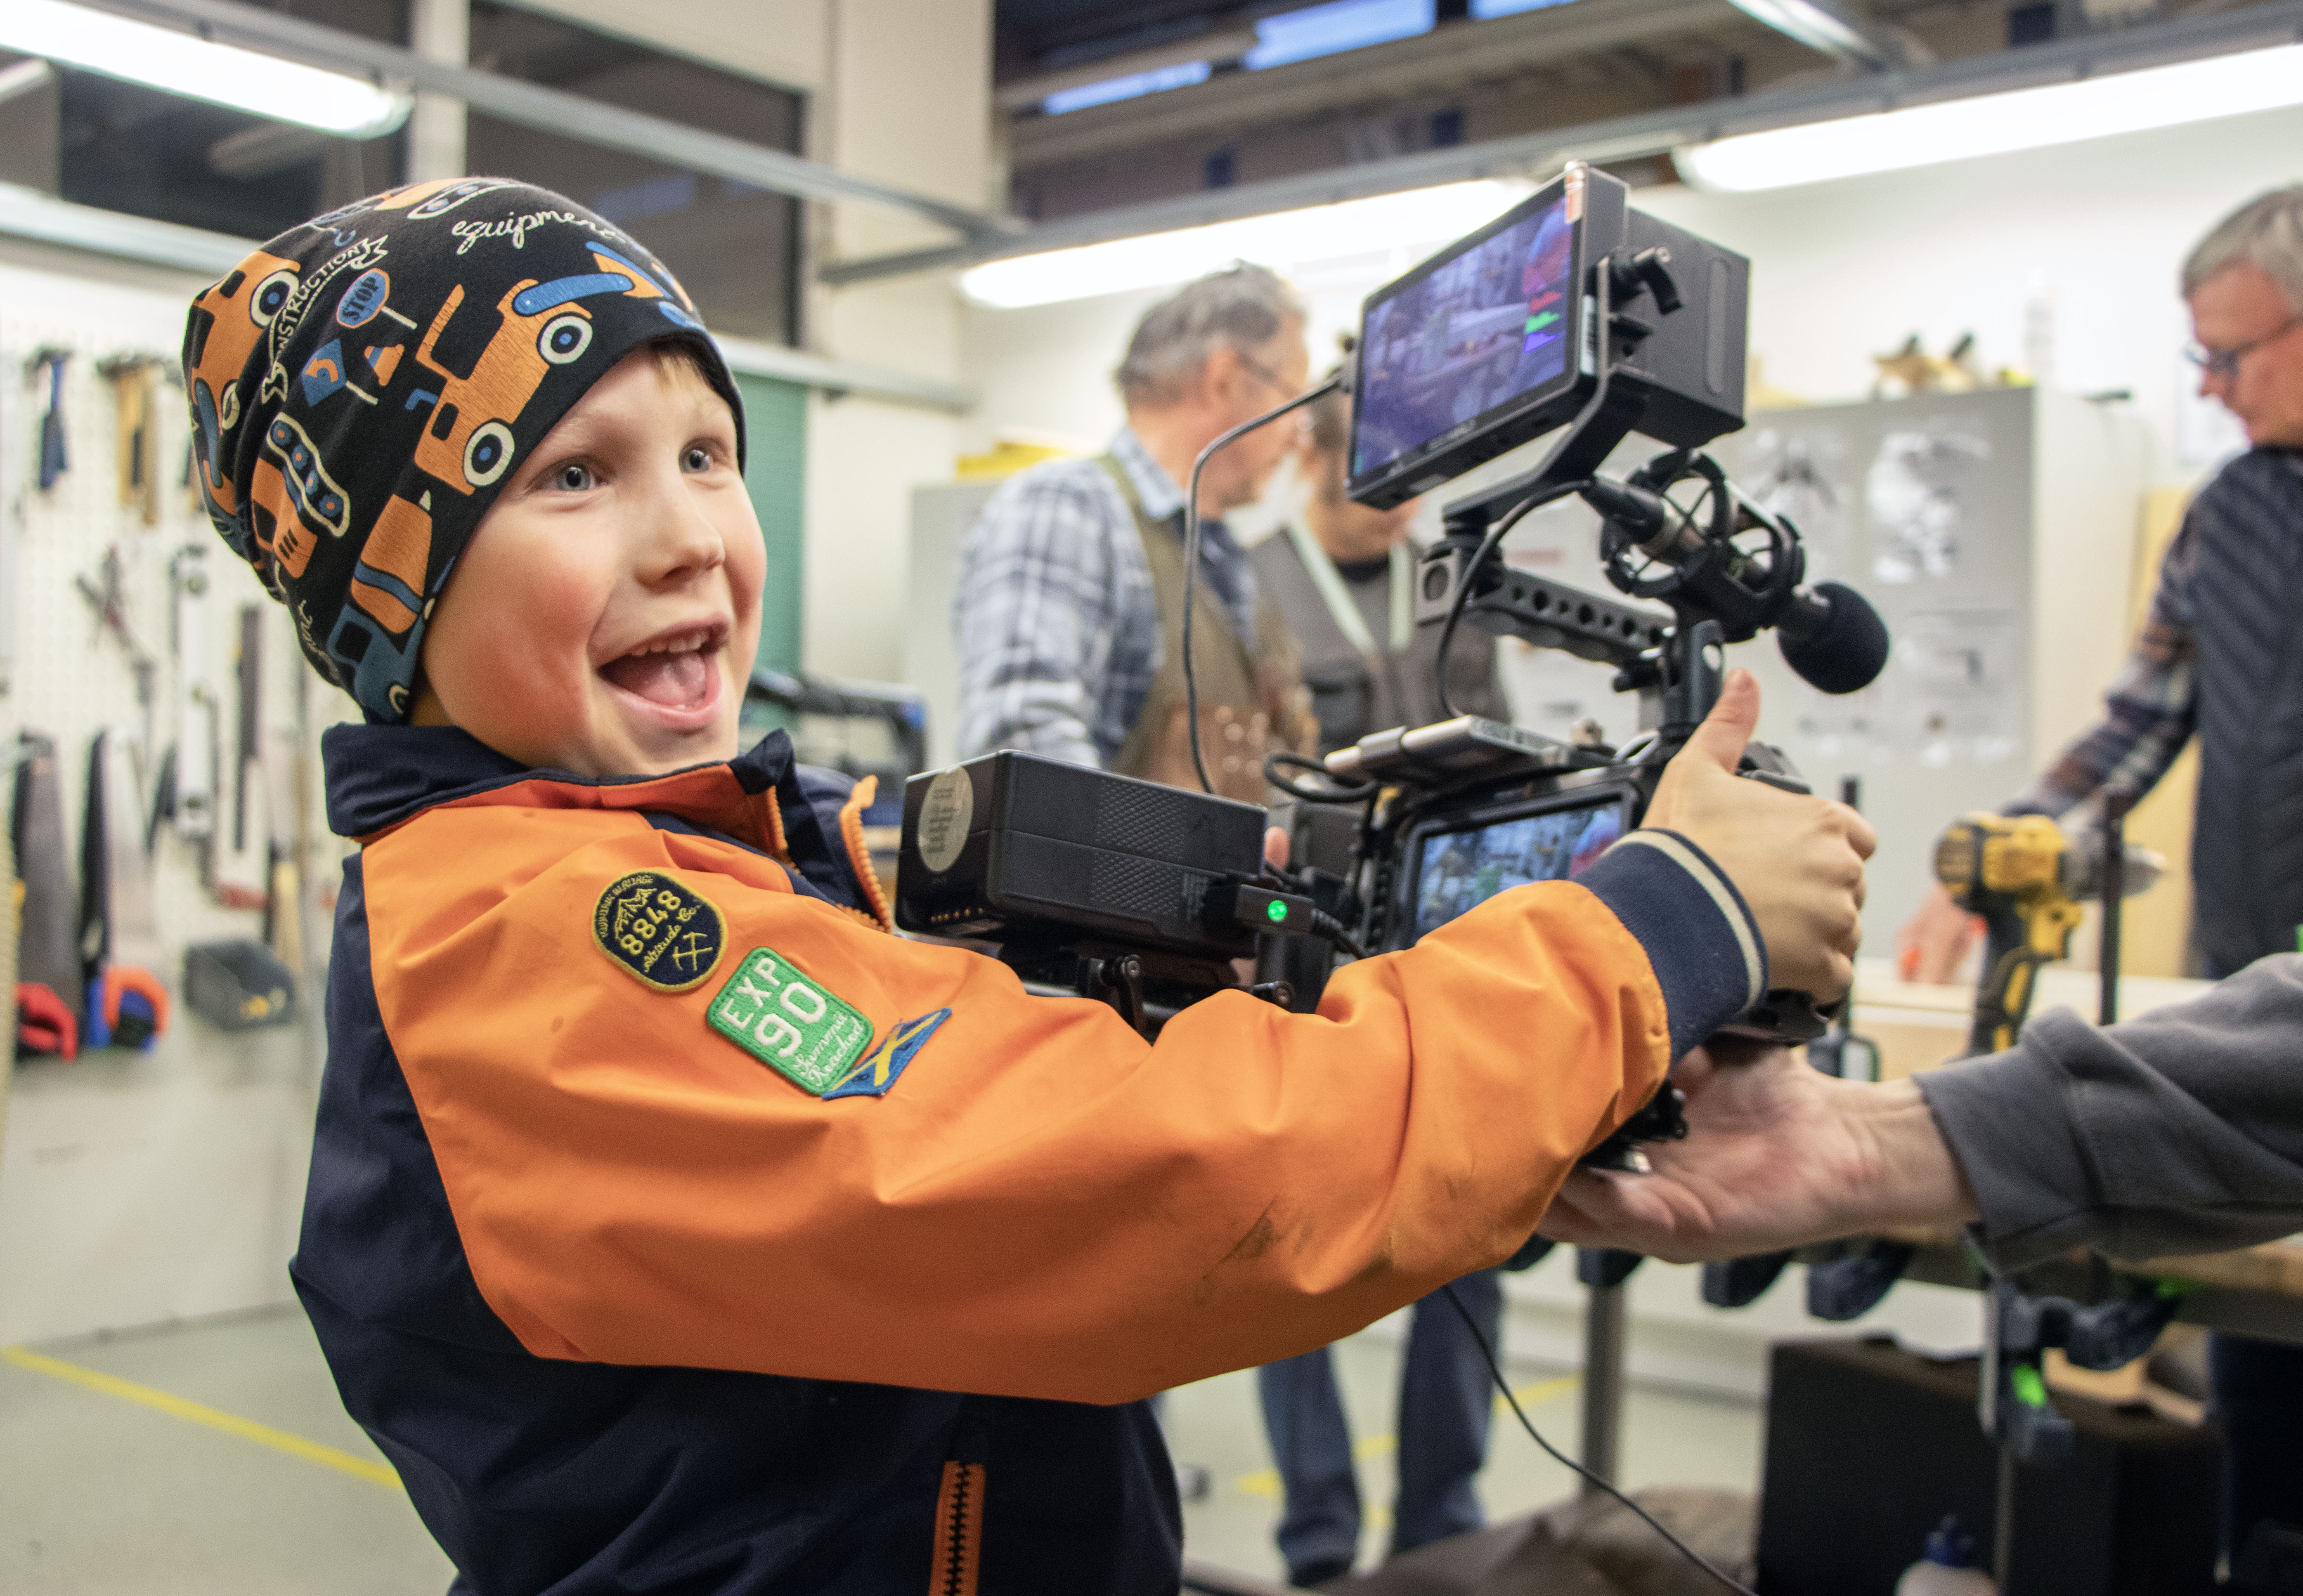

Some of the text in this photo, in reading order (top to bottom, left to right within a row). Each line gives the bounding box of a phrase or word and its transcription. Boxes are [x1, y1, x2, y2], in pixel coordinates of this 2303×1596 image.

[342, 277, 379, 320] STOP
[620, 890, 681, 955] 8848
[719, 958, 780, 1030] EXP
[754, 982, 826, 1058] 90
[792, 1011, 848, 1076] Summit
[809, 1016, 863, 1087] Reached
